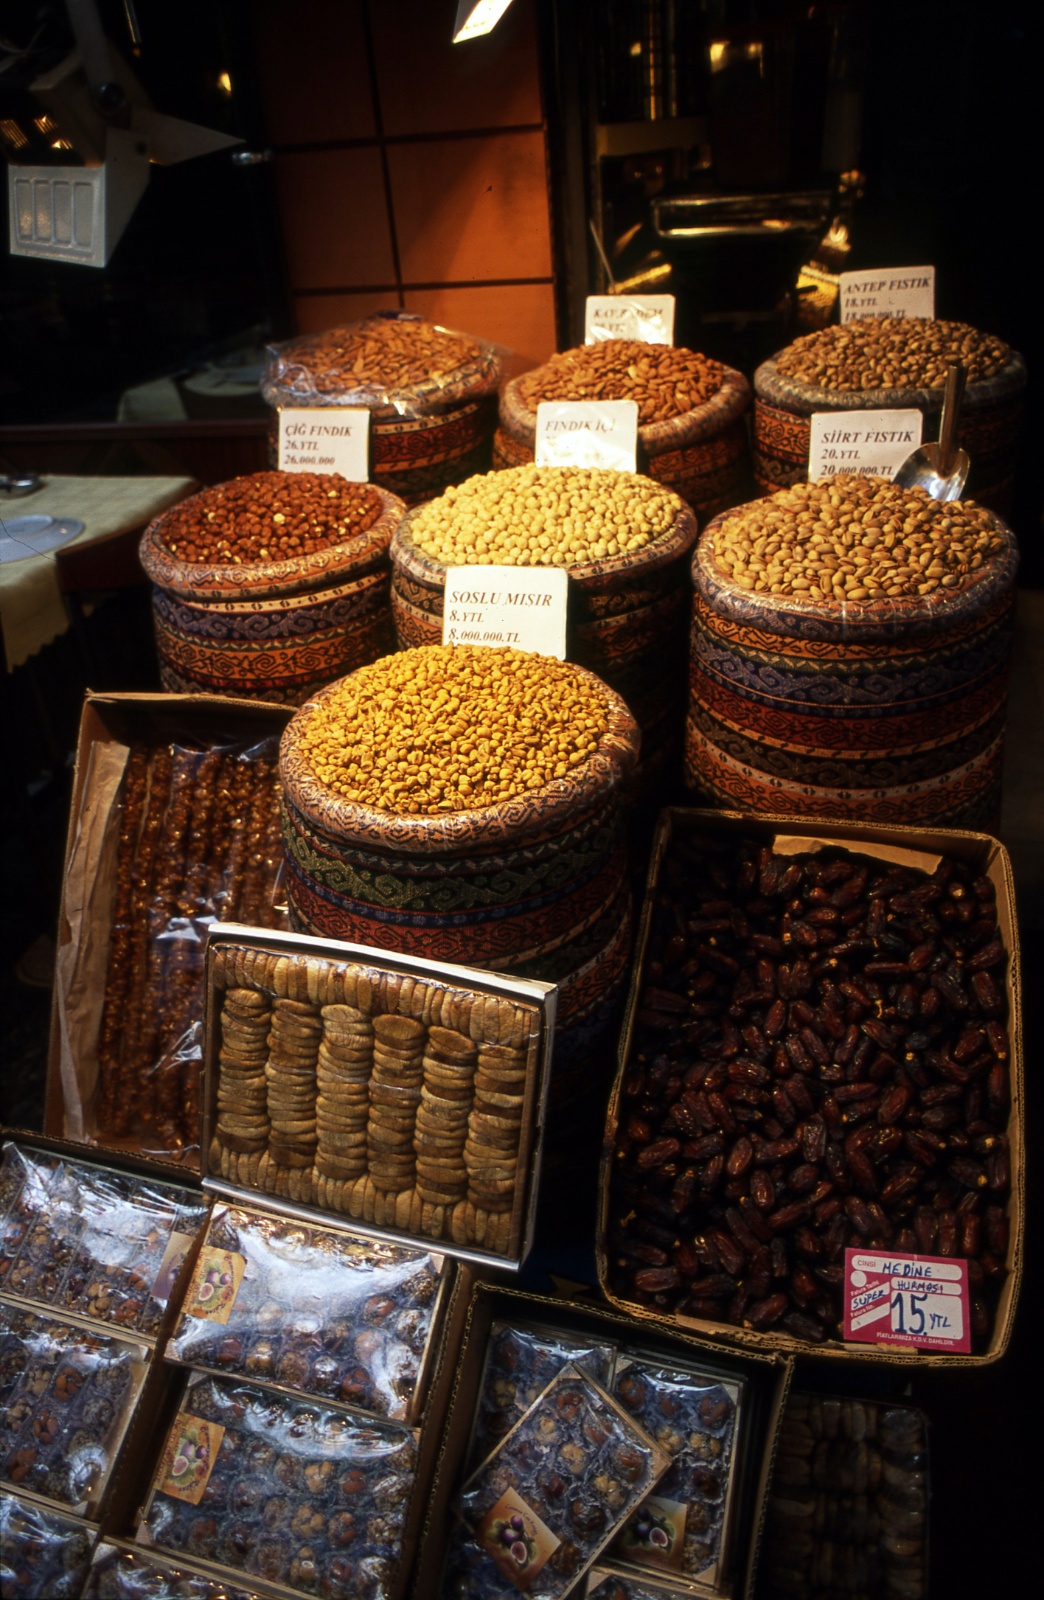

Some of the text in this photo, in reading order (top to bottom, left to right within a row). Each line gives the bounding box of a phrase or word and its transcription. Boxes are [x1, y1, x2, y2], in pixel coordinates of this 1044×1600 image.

[843, 277, 931, 294] ANTEP FISTIK
[285, 422, 353, 438] ÇİĞ FINDIK
[545, 420, 593, 431] FINDIK
[821, 430, 915, 444] SİİRT FISTIK
[284, 440, 319, 451] 26.YTL
[284, 454, 336, 466] 26.000.000
[821, 449, 861, 460] 20.YTL
[449, 590, 553, 607] SOSLU MISIR
[449, 609, 485, 623] 8.YTL
[448, 627, 521, 643] 8.000.000.TL
[929, 1313, 952, 1330] YTL
